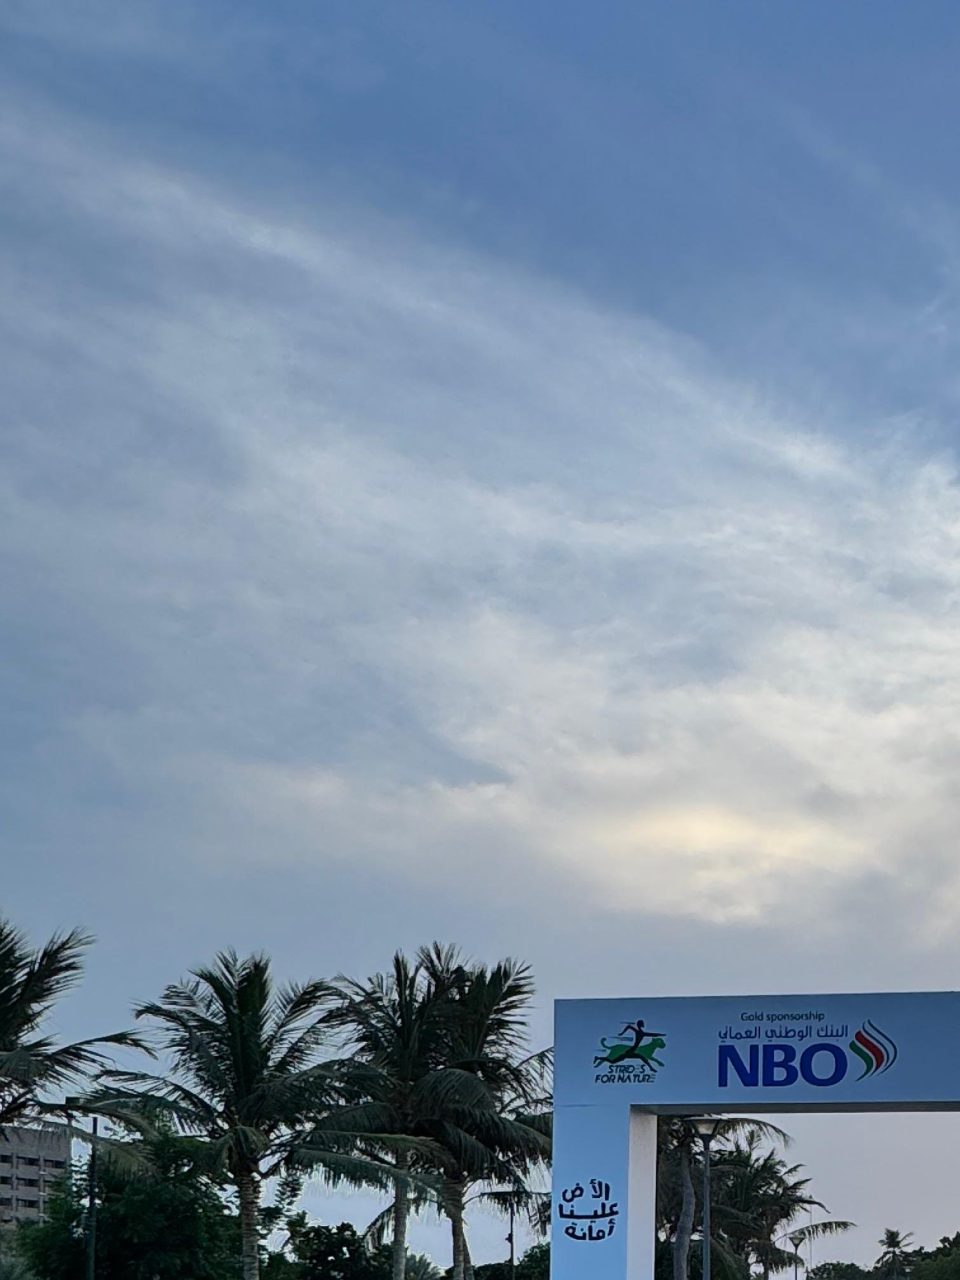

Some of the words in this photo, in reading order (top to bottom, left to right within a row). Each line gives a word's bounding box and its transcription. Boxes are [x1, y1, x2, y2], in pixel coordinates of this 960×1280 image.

[740, 1012, 764, 1021] Gold
[766, 1011, 825, 1023] sponsorship
[718, 1025, 761, 1043] العماني
[765, 1025, 812, 1042] الوطني
[816, 1024, 849, 1041] البنك
[718, 1043, 848, 1087] NBO
[595, 1074, 616, 1084] FOR
[558, 1202, 619, 1223] علينا
[564, 1218, 616, 1240] أمانة
